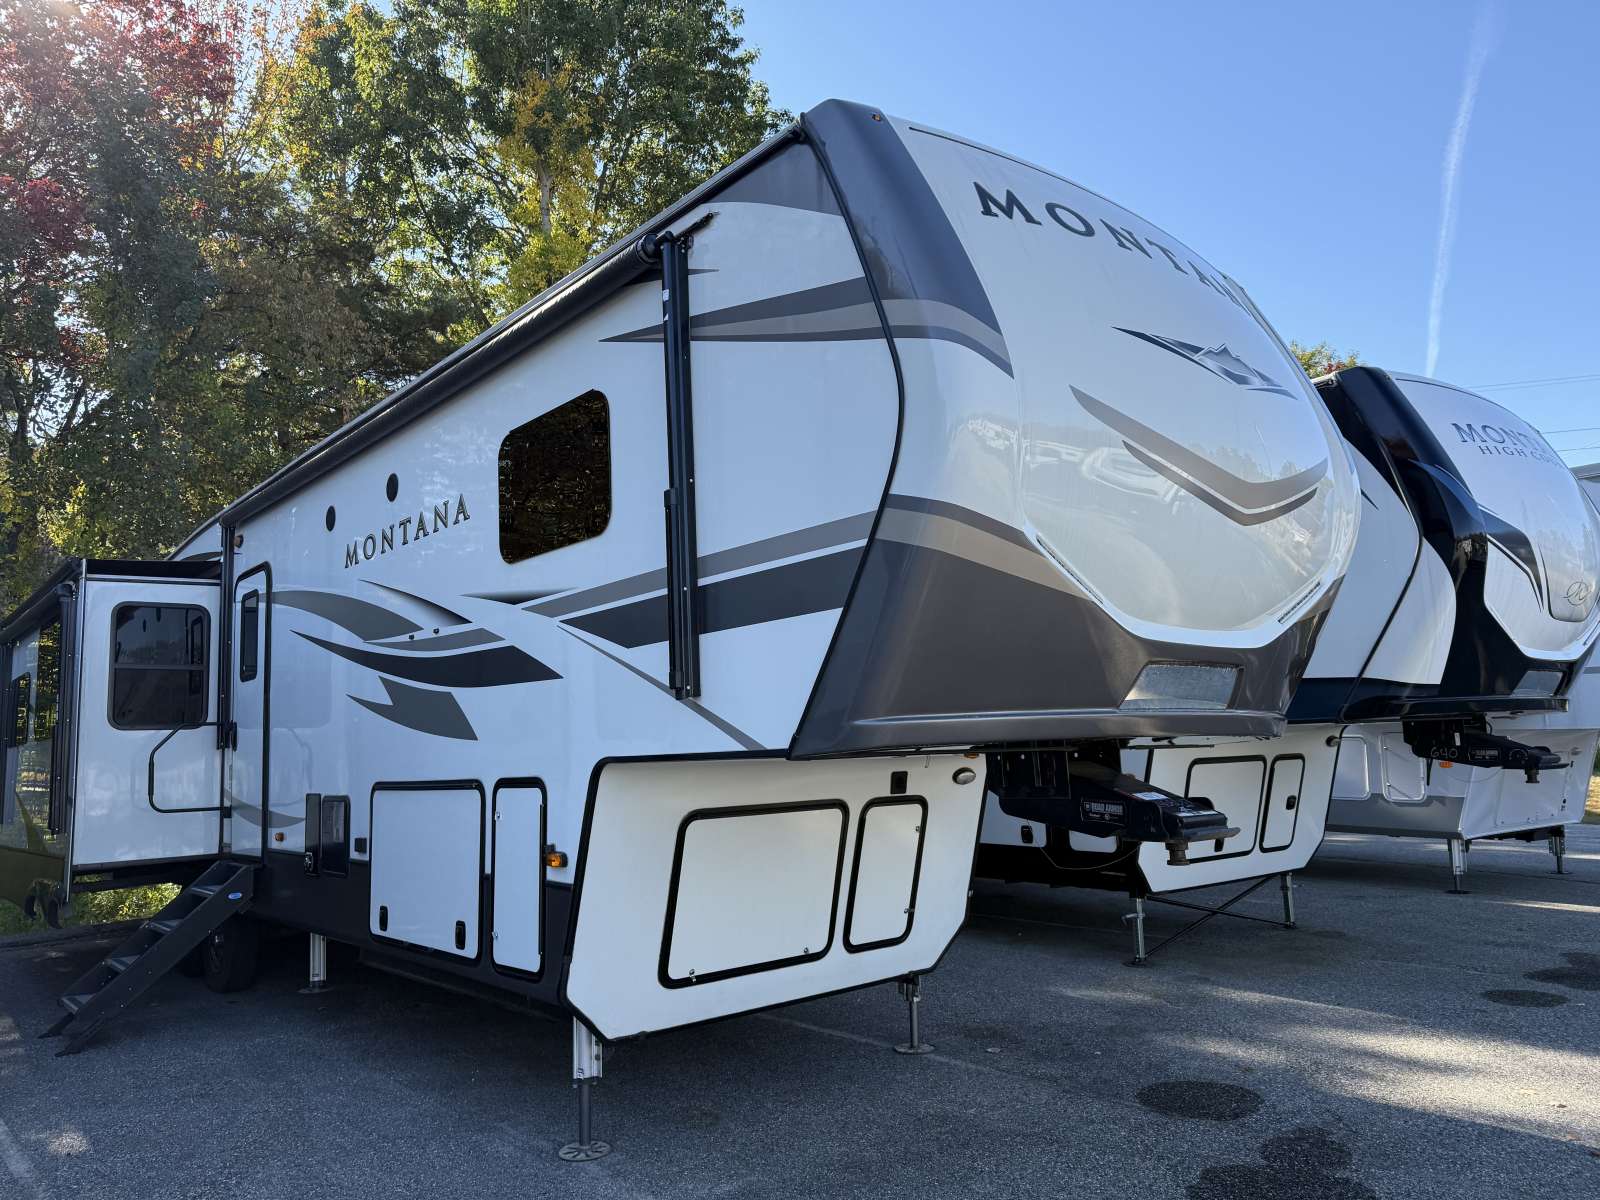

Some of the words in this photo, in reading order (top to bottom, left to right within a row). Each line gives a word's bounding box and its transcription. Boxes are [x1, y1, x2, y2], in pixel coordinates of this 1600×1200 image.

[973, 181, 1252, 318] MONTAN
[1478, 445, 1528, 459] HIGH
[344, 493, 471, 569] MONTANA
